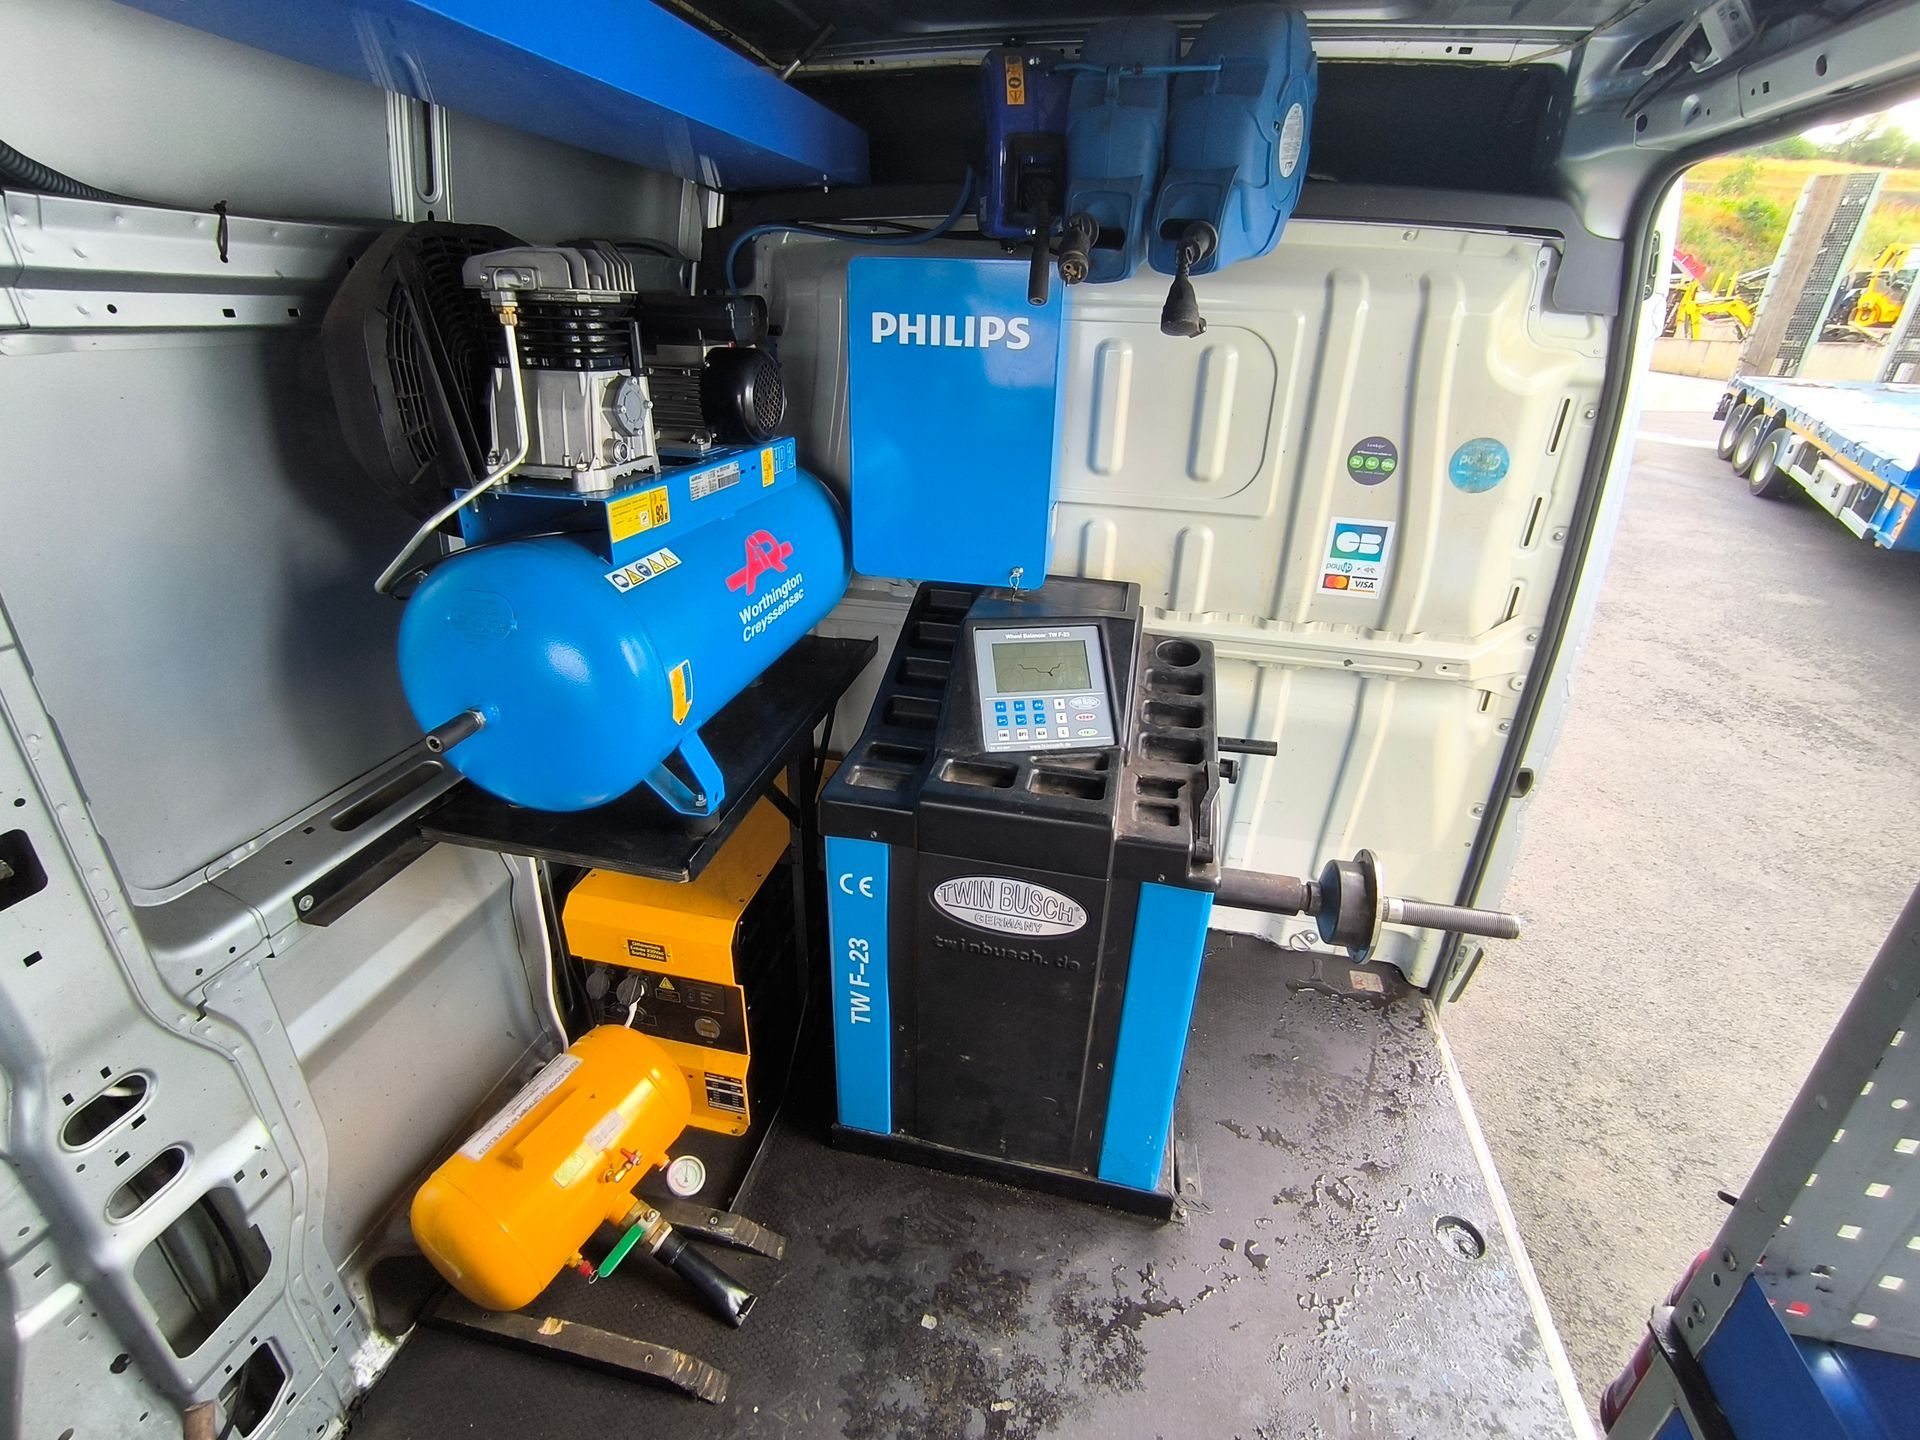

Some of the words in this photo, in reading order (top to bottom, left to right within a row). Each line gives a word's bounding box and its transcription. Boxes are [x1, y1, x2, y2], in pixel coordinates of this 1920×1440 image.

[872, 312, 1031, 350] PHILIPS
[656, 504, 664, 523] 93
[739, 573, 803, 625] Worthington
[1355, 581, 1374, 589] VISA
[743, 589, 805, 642] Creyssensac
[839, 873, 873, 898] CE
[940, 880, 995, 909] TWIN
[974, 912, 1043, 933] GERMANY
[848, 937, 870, 988] F-23
[850, 991, 871, 1025] TW
